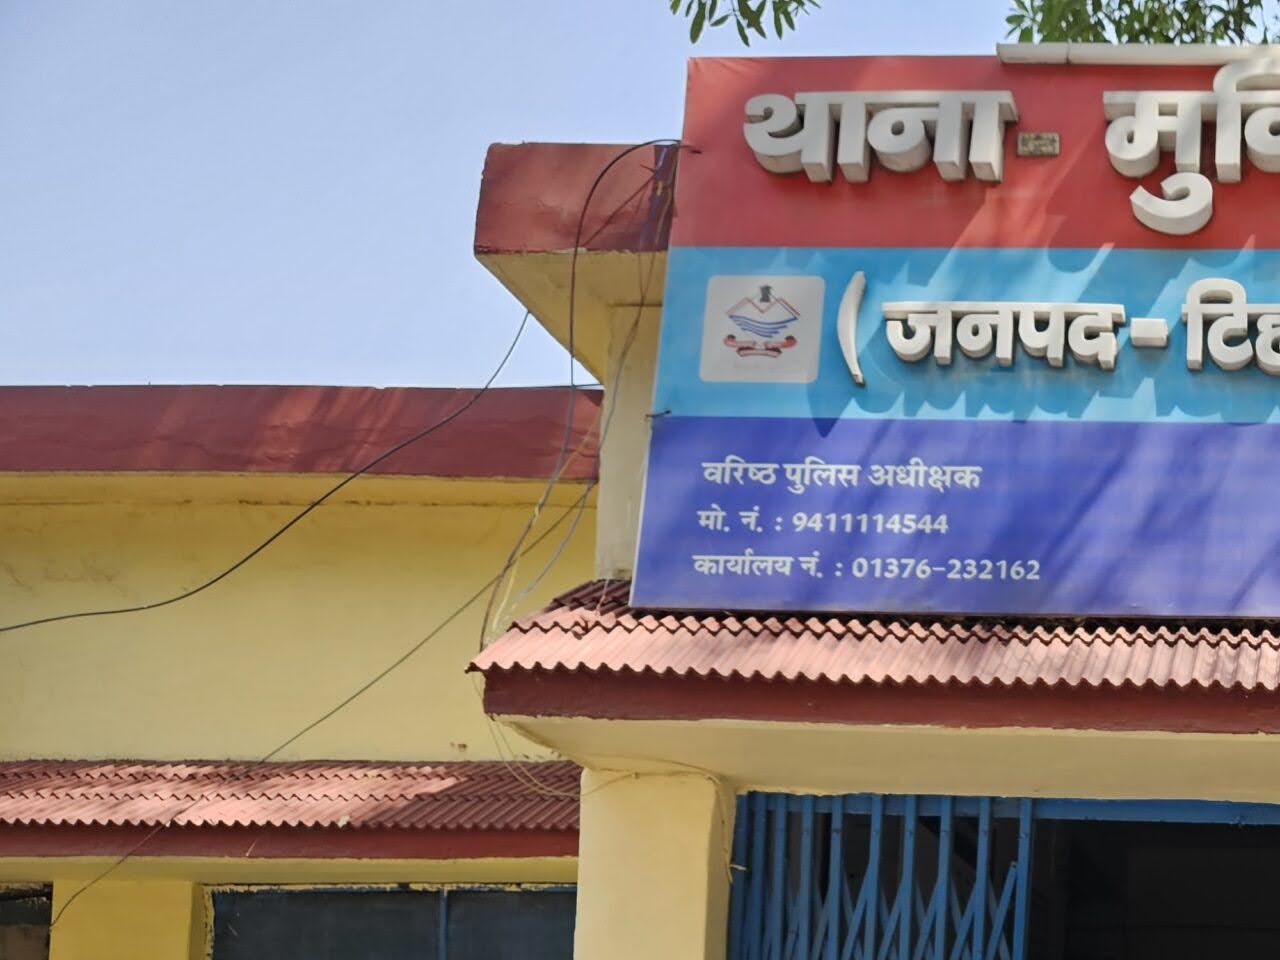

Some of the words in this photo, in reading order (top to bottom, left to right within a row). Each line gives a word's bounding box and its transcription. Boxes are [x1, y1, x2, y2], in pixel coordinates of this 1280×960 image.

[702, 455, 779, 485] वरिष्ठ
[783, 457, 861, 494] पुलिस
[869, 457, 982, 492] अधीक्षक
[697, 503, 729, 532] मो.
[739, 506, 762, 533] नं.
[792, 512, 949, 534] 9411114544
[692, 548, 793, 576] कार्यालय
[798, 551, 823, 578] नं.
[852, 558, 1040, 580] 01376-232162
